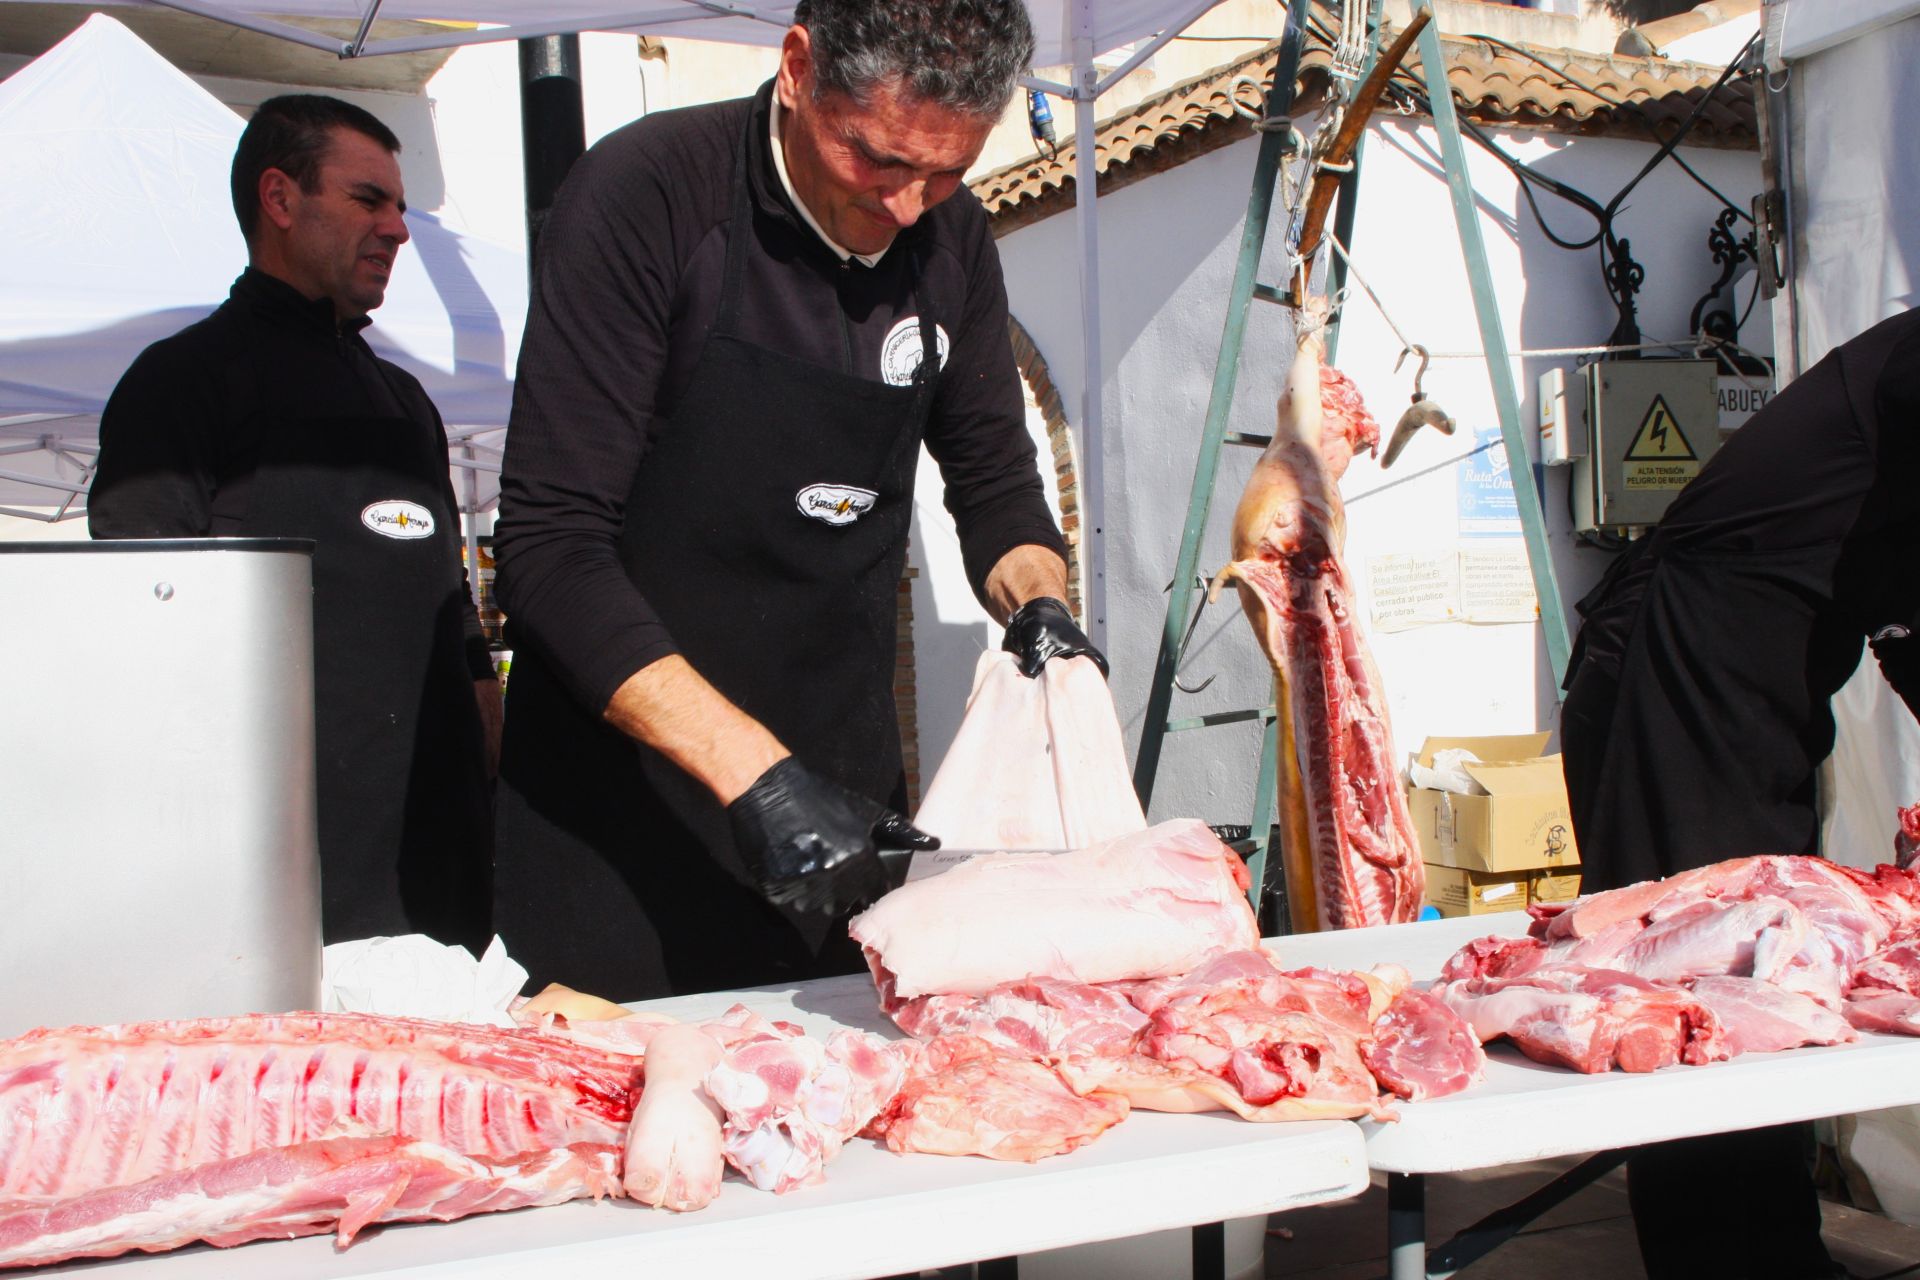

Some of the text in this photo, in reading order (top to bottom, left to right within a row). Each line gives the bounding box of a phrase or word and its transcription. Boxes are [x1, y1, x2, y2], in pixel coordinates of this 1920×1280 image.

[1464, 469, 1492, 482] Ruta
[1637, 465, 1685, 475] ALTA TENSIÓN
[1626, 476, 1697, 485] PELIGRO DE MUERT
[1375, 592, 1444, 607] cerrada al público
[1378, 607, 1415, 621] por obras
